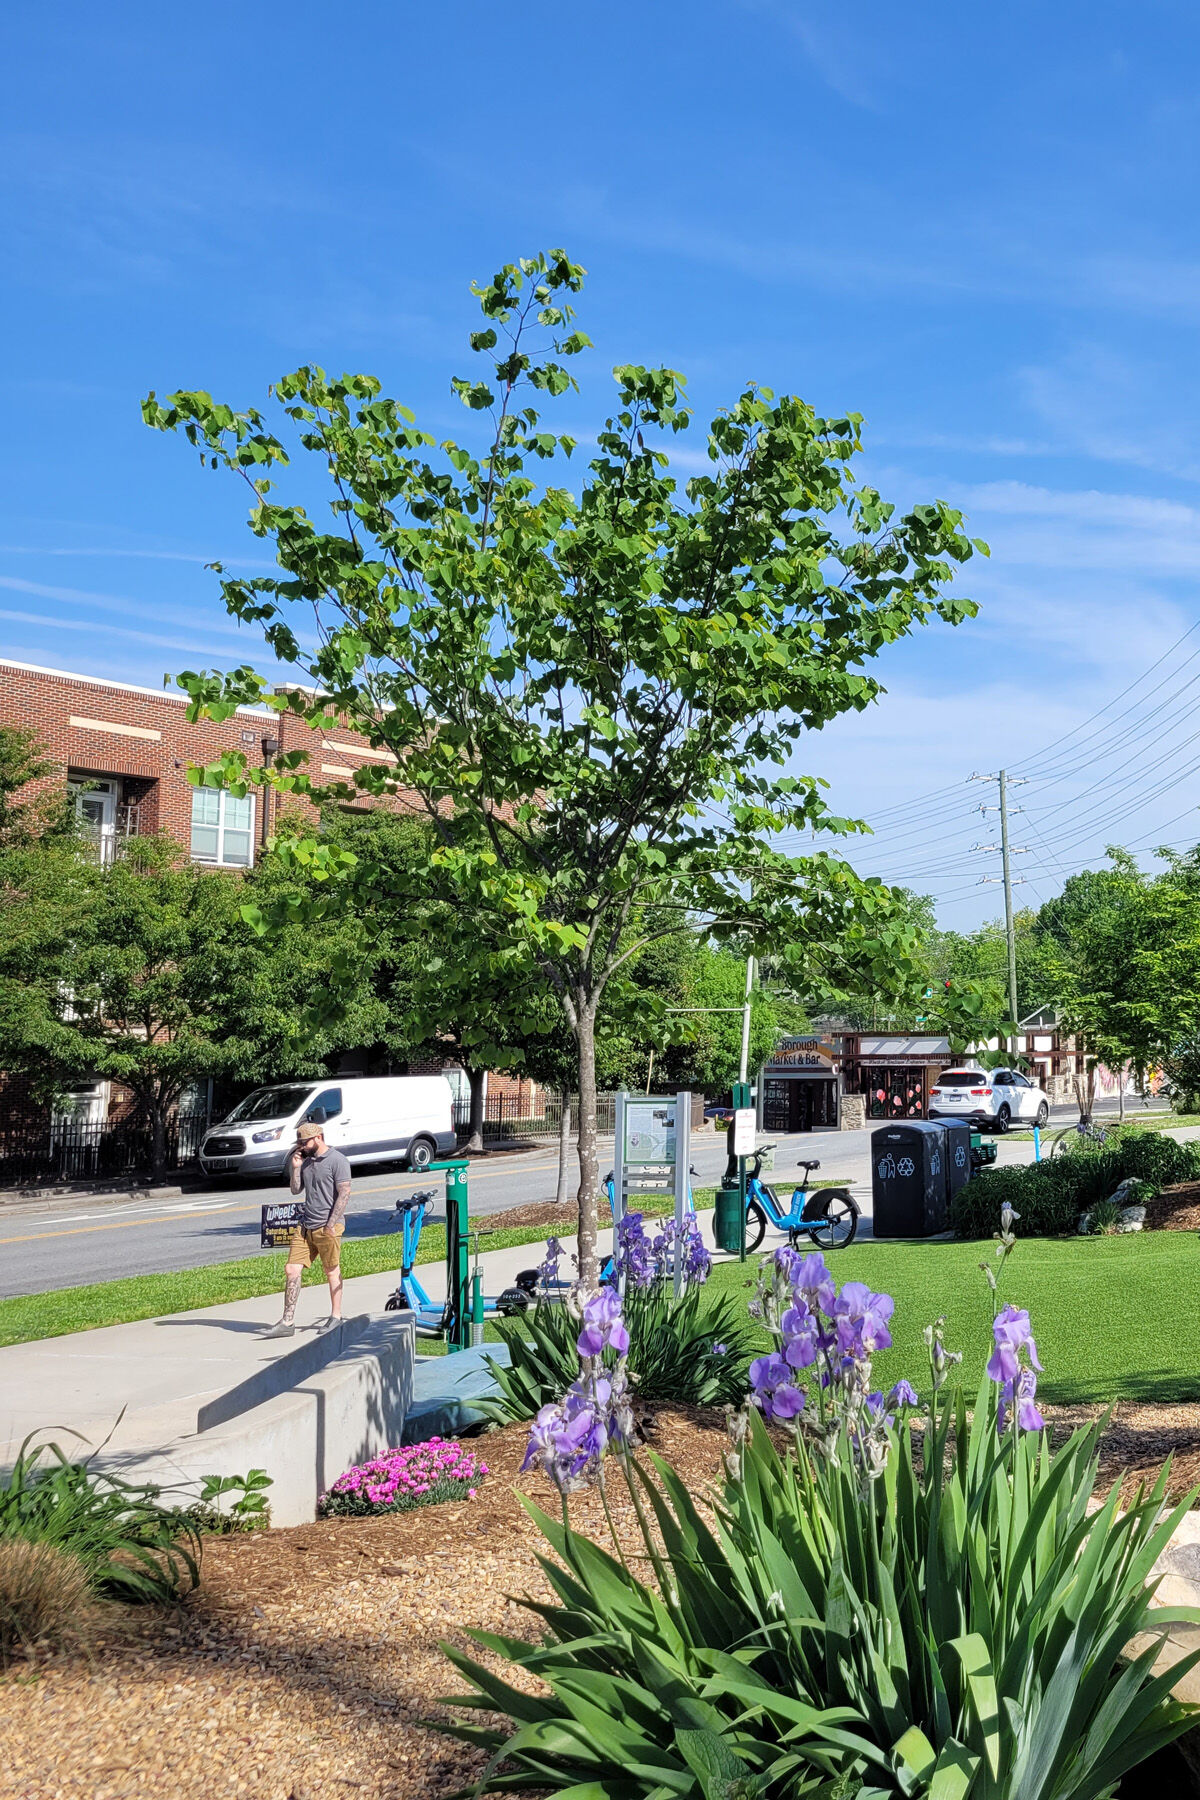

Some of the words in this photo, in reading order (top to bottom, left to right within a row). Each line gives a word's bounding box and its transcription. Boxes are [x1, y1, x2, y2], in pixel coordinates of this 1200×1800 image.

[781, 1038, 818, 1053] Borough
[798, 1053, 804, 1065] &
[805, 1053, 820, 1065] Bar
